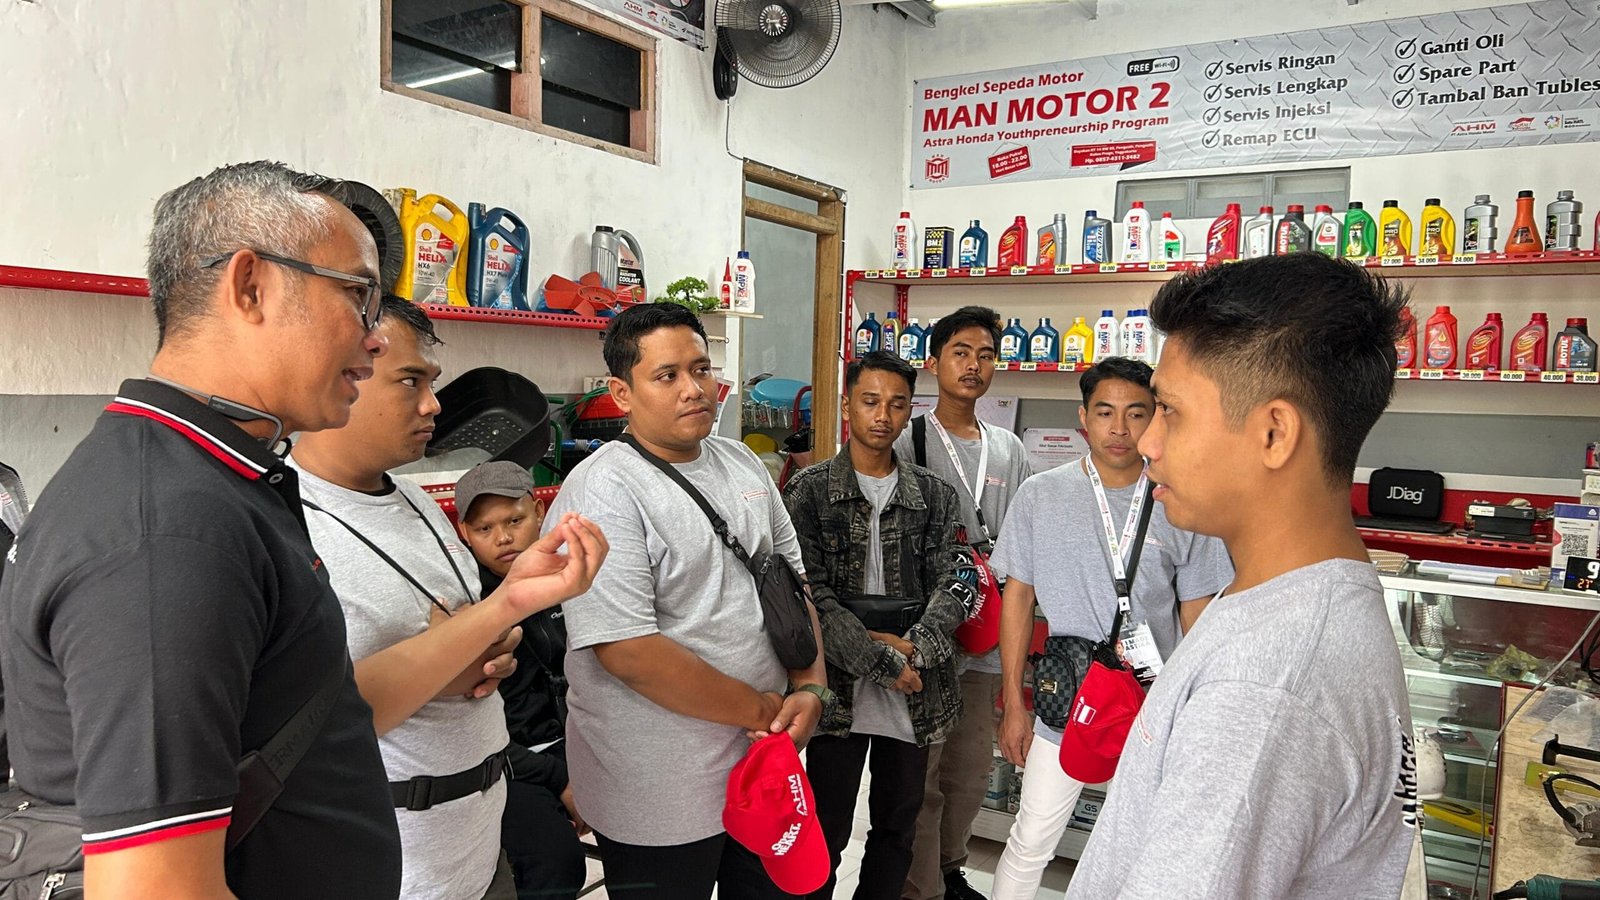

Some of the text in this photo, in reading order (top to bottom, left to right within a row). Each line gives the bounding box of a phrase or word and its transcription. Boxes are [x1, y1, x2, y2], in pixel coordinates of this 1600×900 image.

[1421, 34, 1504, 54] Ganti Oli
[1129, 63, 1150, 73] FREE
[1225, 54, 1336, 75] Servis Ringan
[1420, 60, 1516, 82] Spare Part
[924, 72, 1084, 100] Bengkel Sepeda Motor
[1224, 77, 1348, 99] Servis Lengkap
[1418, 87, 1486, 105] Tambal
[1493, 85, 1528, 98] Ban
[923, 82, 1171, 132] MAN MOTOR 2
[1224, 102, 1331, 123] Servis Injeksi
[924, 116, 1168, 148] Astra Honda Youthpreneurship Program
[1222, 128, 1316, 146] Remap ECU
[1452, 122, 1496, 132] AHM
[418, 252, 447, 263] HELIX
[487, 260, 511, 272] HELIX
[1560, 339, 1568, 365] MOTUL
[1386, 486, 1423, 504] JDiag
[788, 775, 807, 816] AHM
[1084, 804, 1098, 813] GS
